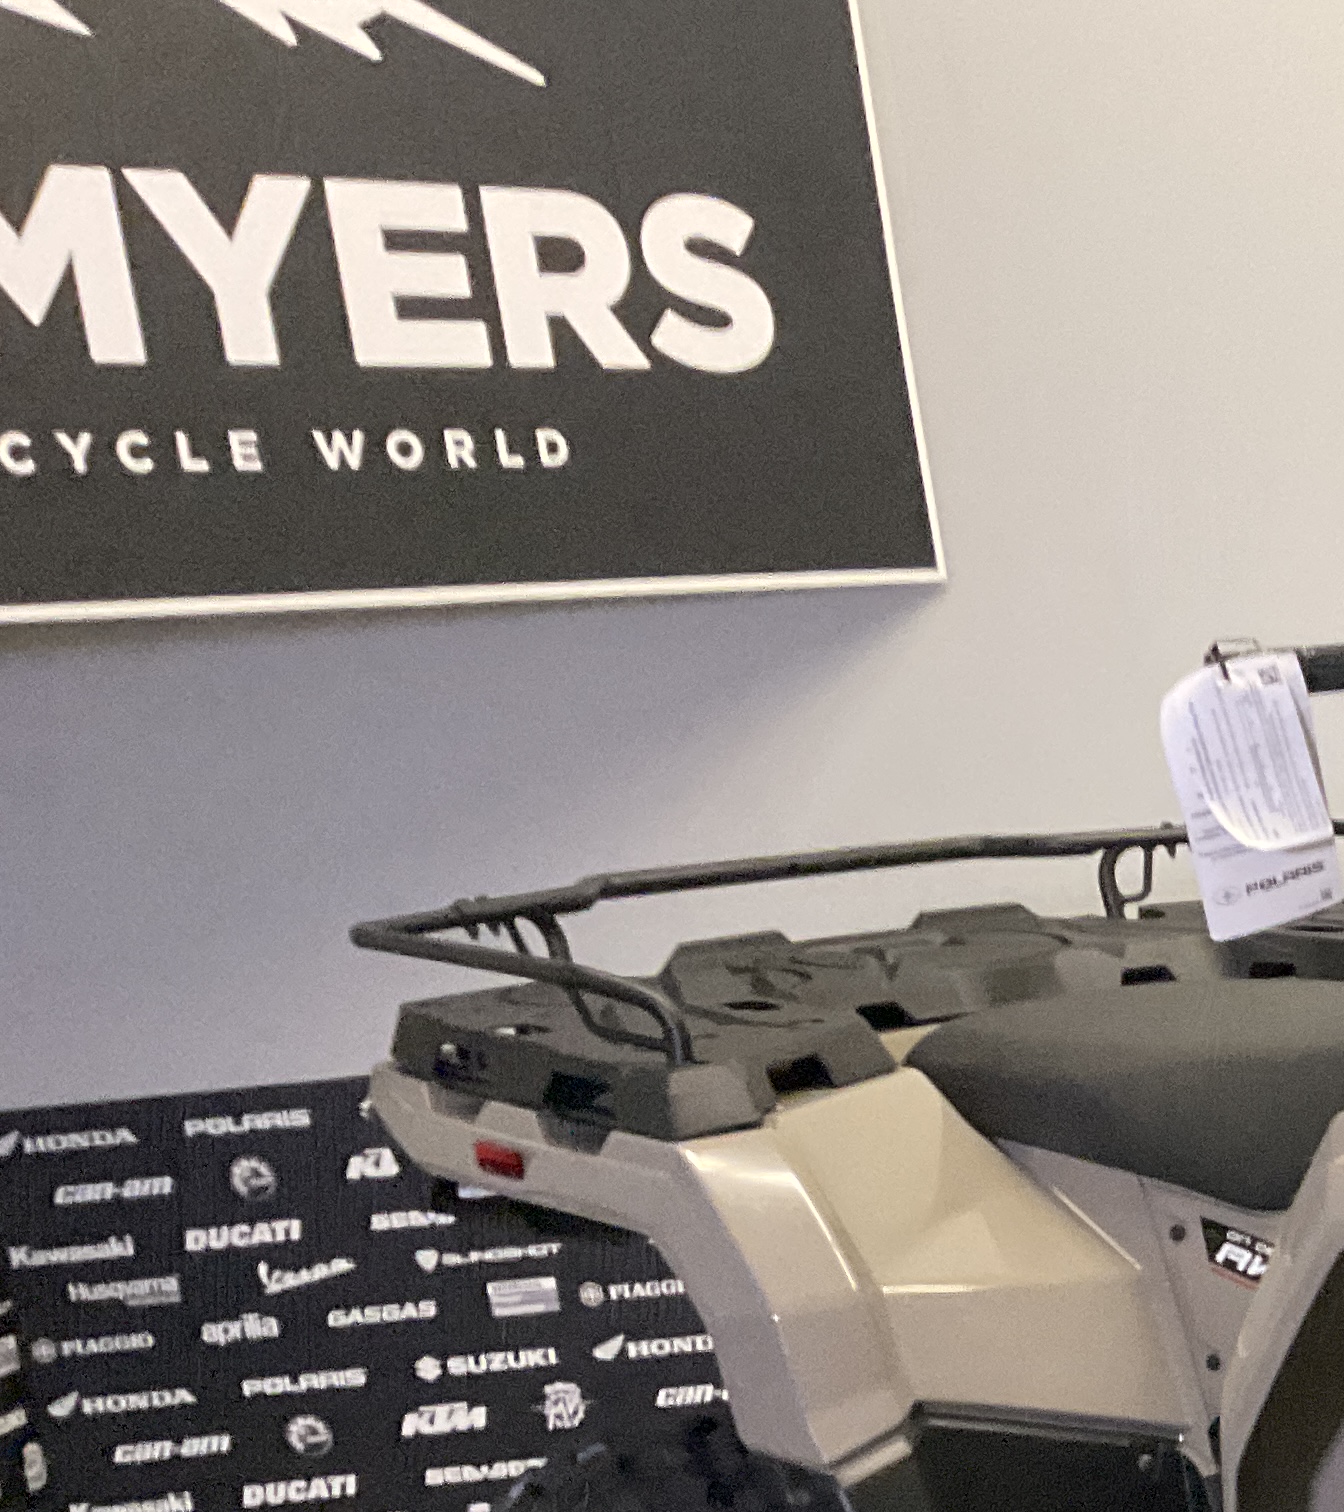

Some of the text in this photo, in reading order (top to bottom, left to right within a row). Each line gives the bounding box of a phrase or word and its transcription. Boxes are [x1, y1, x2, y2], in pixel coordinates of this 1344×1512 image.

[0, 164, 775, 374] MYERS
[312, 428, 569, 470] WORLD
[1245, 859, 1325, 896] POLARIS
[22, 1127, 139, 1153] HONDA
[183, 1108, 312, 1138] POLARIS
[184, 1218, 302, 1252] DUCATI
[607, 1279, 685, 1301] PIAGGI
[201, 1312, 280, 1347] aprilia
[326, 1299, 438, 1328] GASGAS
[627, 1333, 714, 1359] HOND
[446, 1346, 560, 1383] SUZUKI
[241, 1367, 367, 1398] POLARIS
[80, 1388, 197, 1416] HONDA
[400, 1400, 488, 1438] KTM
[242, 1473, 358, 1509] DUCATI
